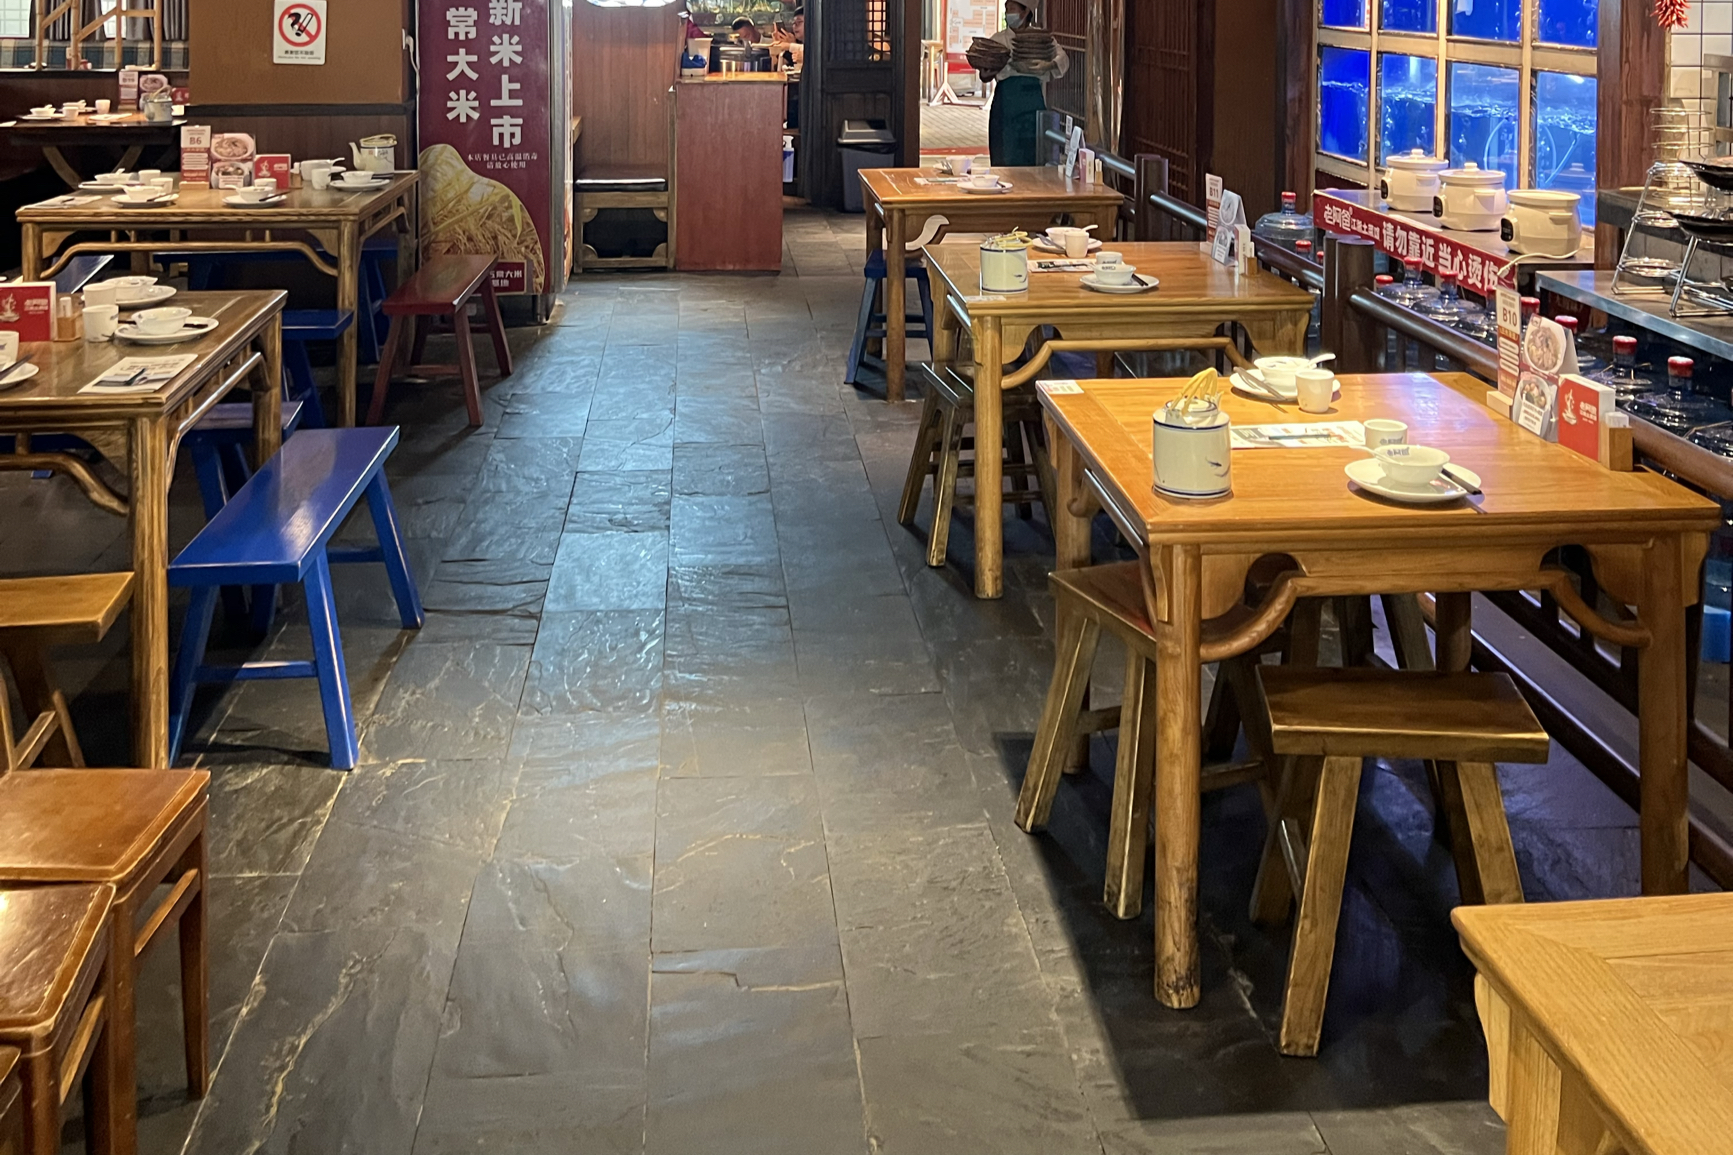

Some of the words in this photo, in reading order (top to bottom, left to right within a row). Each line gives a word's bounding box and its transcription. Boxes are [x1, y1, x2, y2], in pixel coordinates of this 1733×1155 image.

[1209, 186, 1220, 199] B11
[1382, 221, 1435, 269] 请勿靠近
[1438, 242, 1499, 292] 当心烫伤
[1502, 306, 1518, 327] B10
